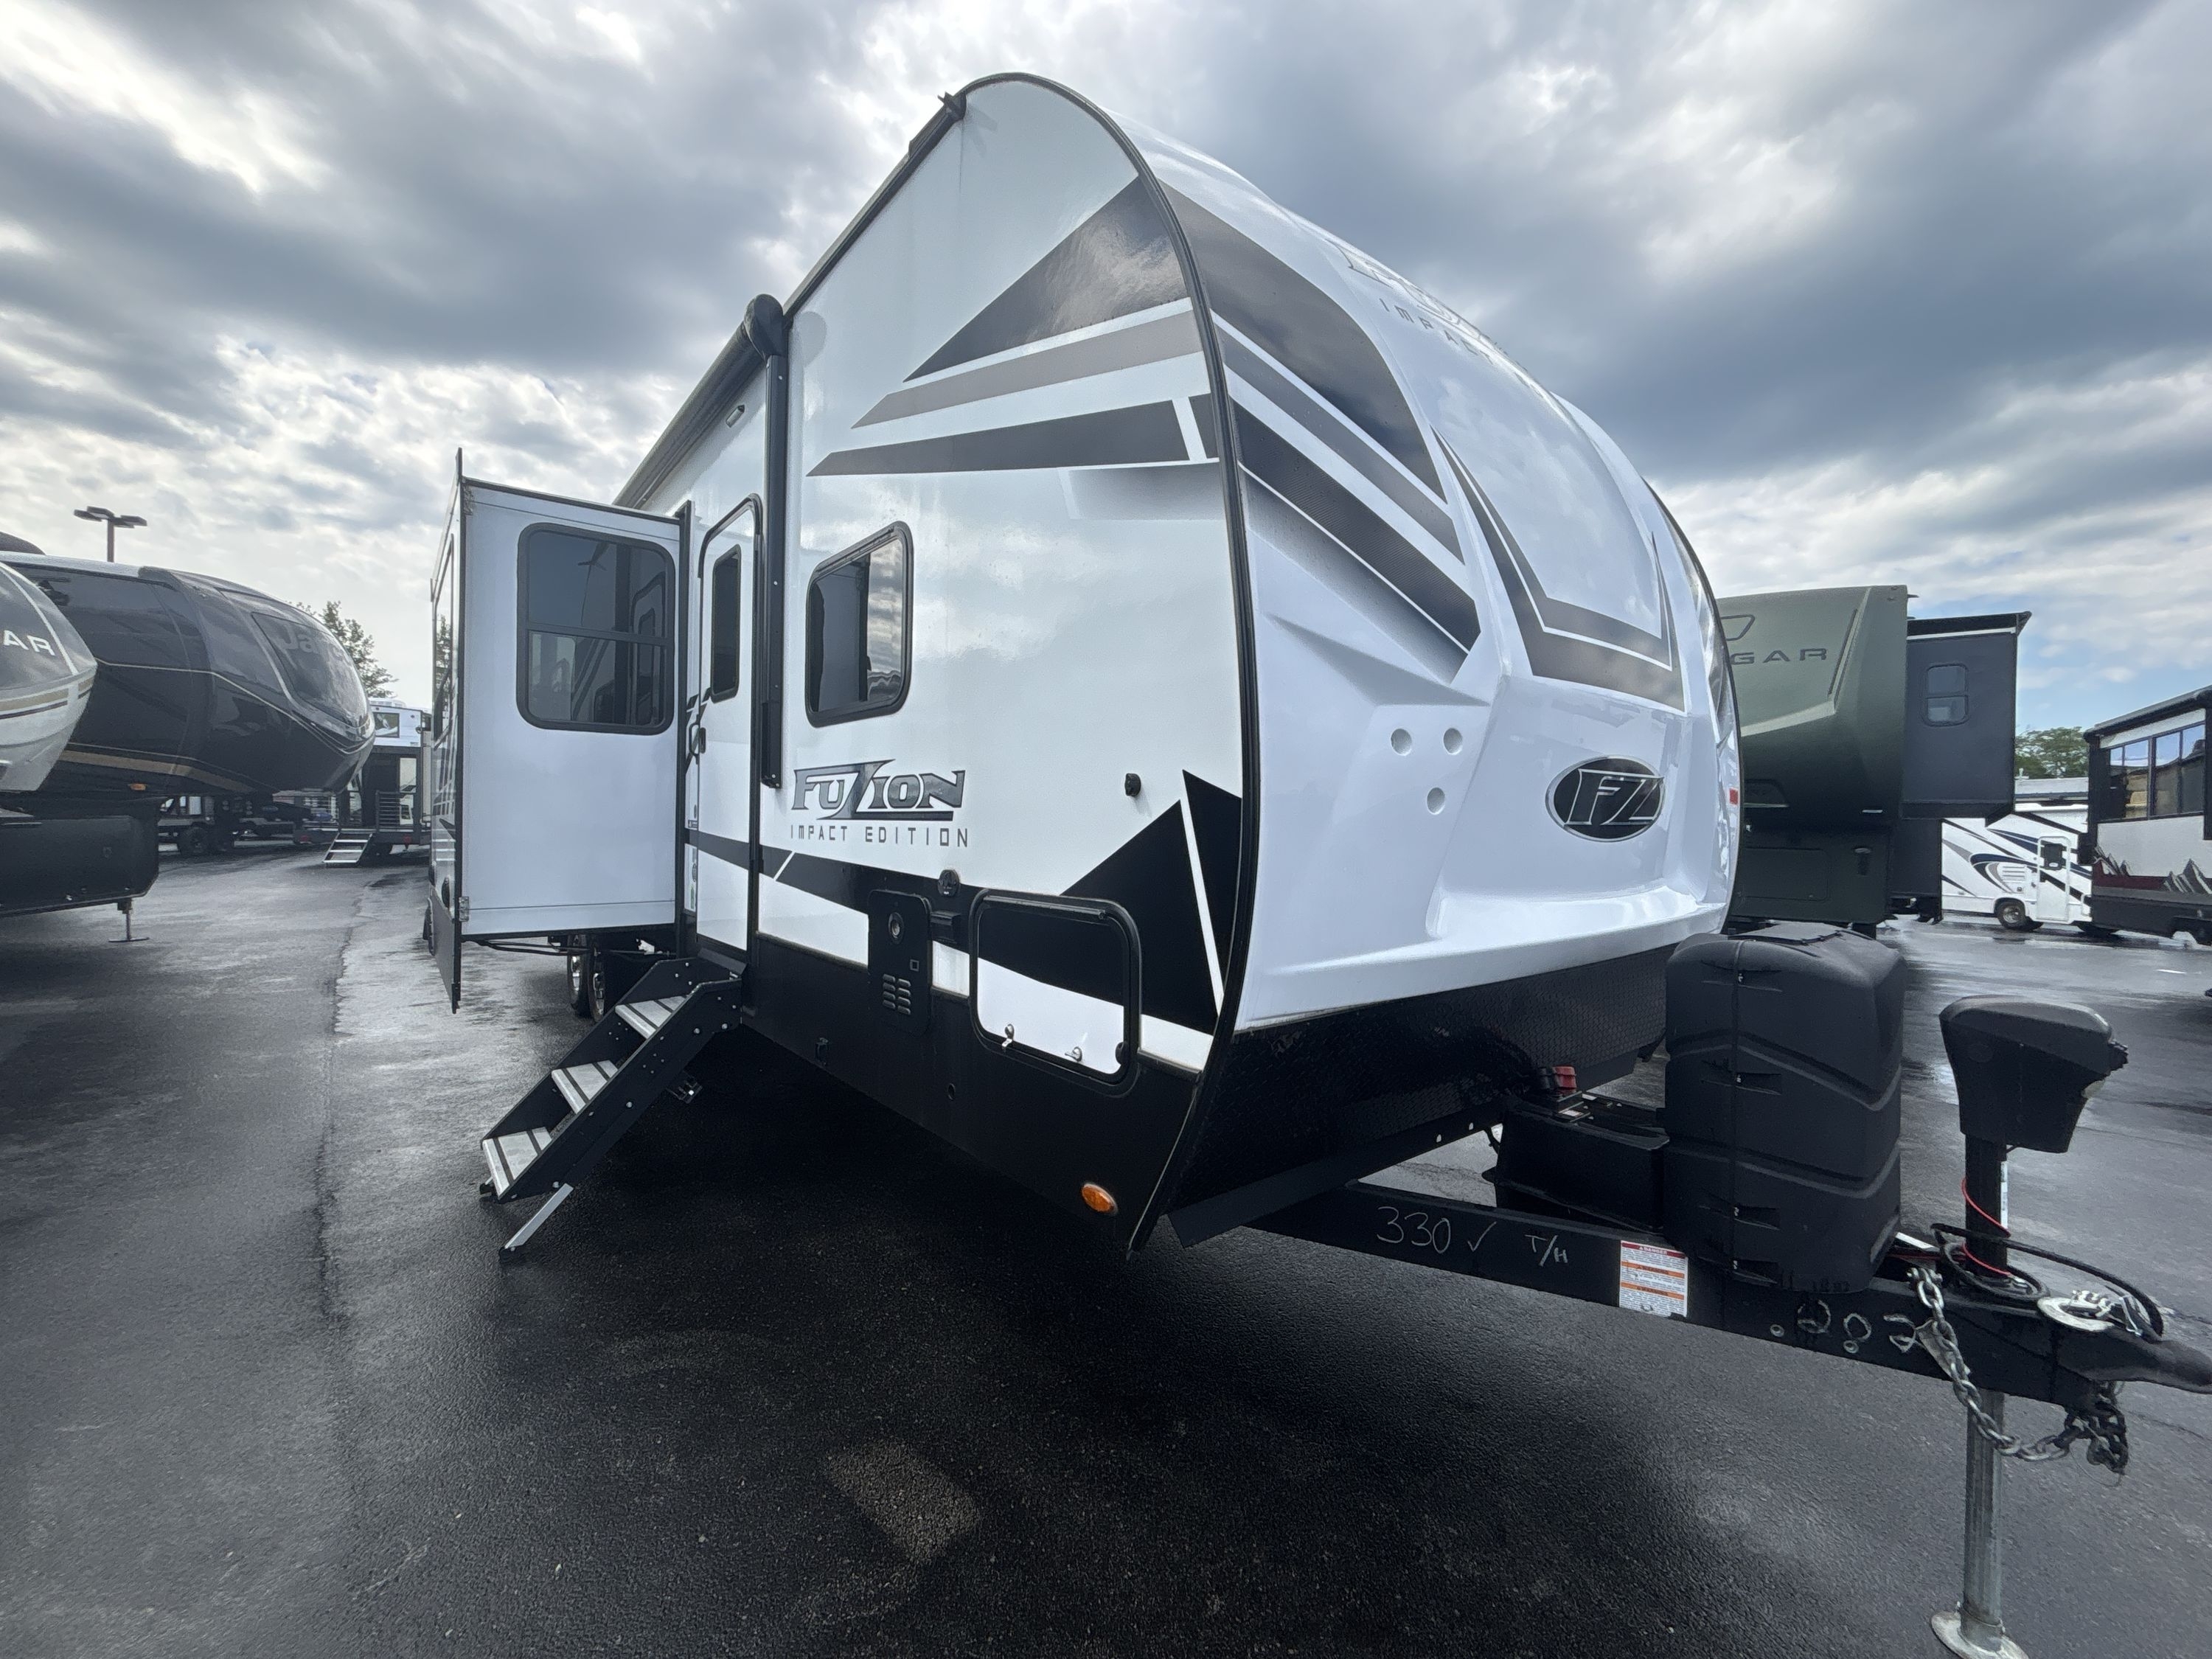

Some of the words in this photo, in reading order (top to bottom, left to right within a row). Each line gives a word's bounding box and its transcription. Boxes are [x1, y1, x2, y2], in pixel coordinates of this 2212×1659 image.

[791, 759, 966, 821] FUZION
[1563, 768, 1664, 826] FZ
[790, 824, 847, 841] IMPACT
[865, 826, 967, 847] EDITION
[1377, 1206, 1451, 1253] 330
